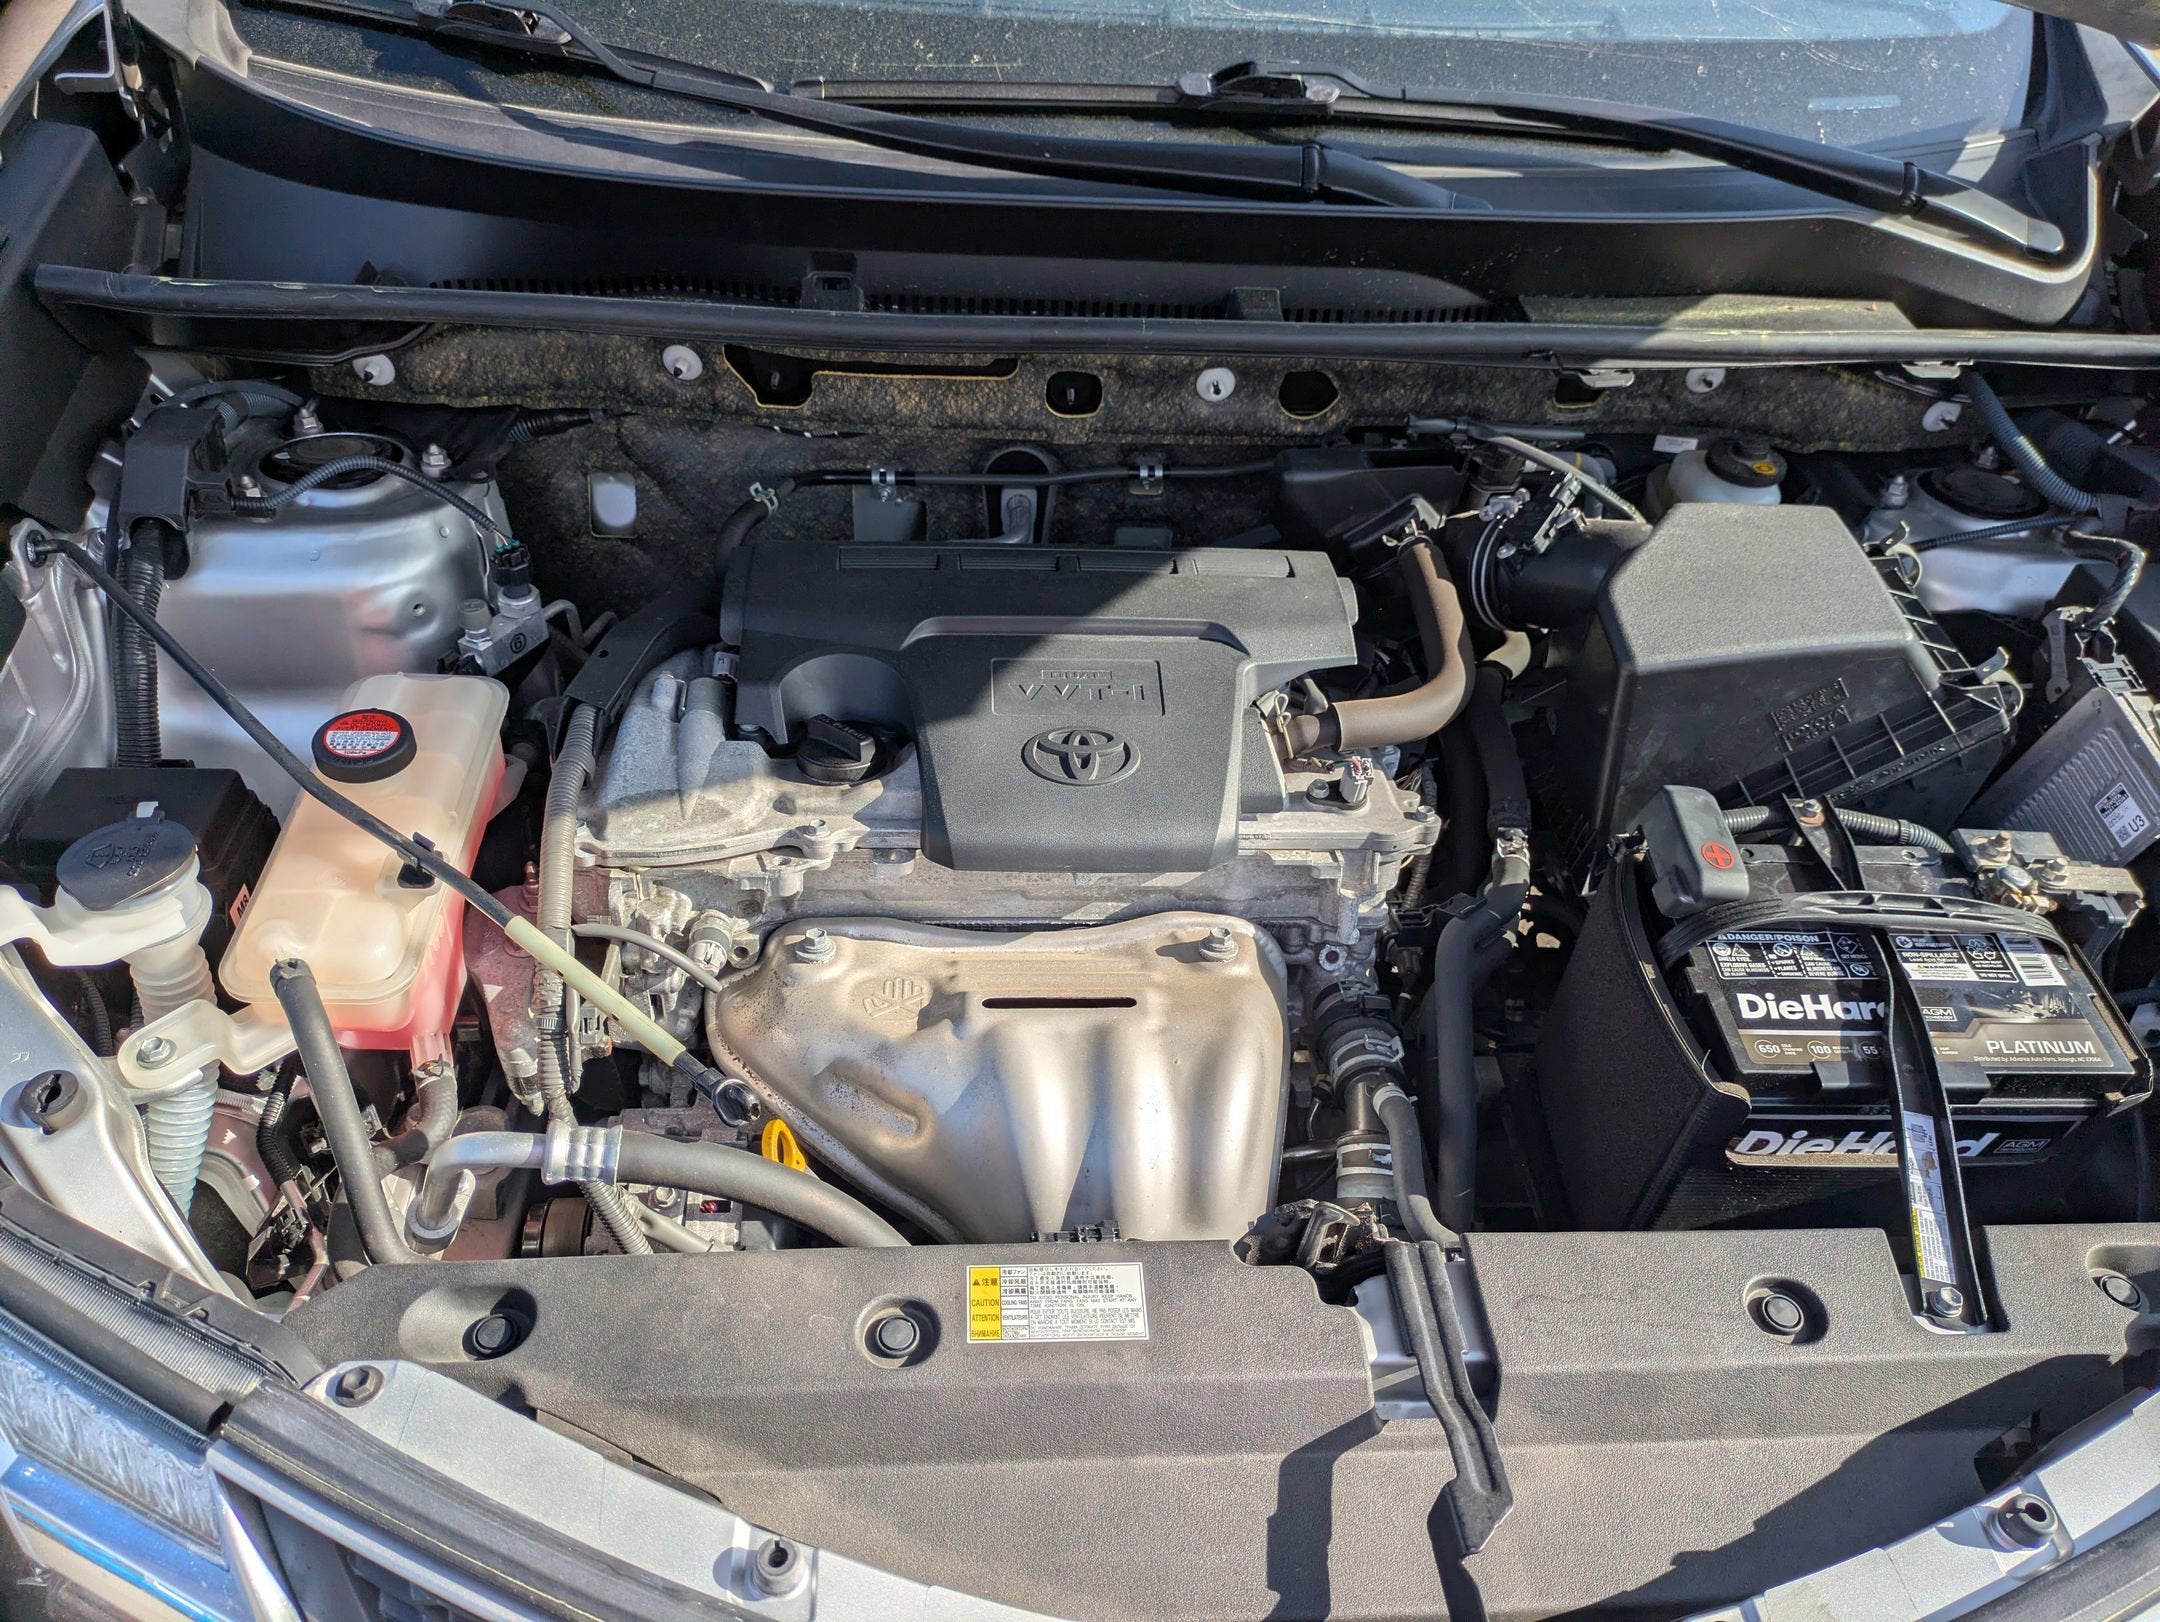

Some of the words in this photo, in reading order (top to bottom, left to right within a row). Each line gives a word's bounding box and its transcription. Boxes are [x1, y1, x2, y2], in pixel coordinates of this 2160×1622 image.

[1008, 683, 1145, 701] VVT-i
[2128, 815, 2145, 833] U3
[1727, 934, 1819, 942] DANGER/POISON
[1736, 993, 1885, 1020] DieHar
[1759, 1044, 1780, 1054] 650
[1811, 1045, 1831, 1054] 100
[1862, 1046, 1878, 1055] 55
[1985, 1040, 2096, 1054] PLATINUM
[972, 1299, 999, 1307] CAUTION
[972, 1314, 1000, 1322] ATTENTION
[971, 1330, 1000, 1338] ВНИМАНИЕ
